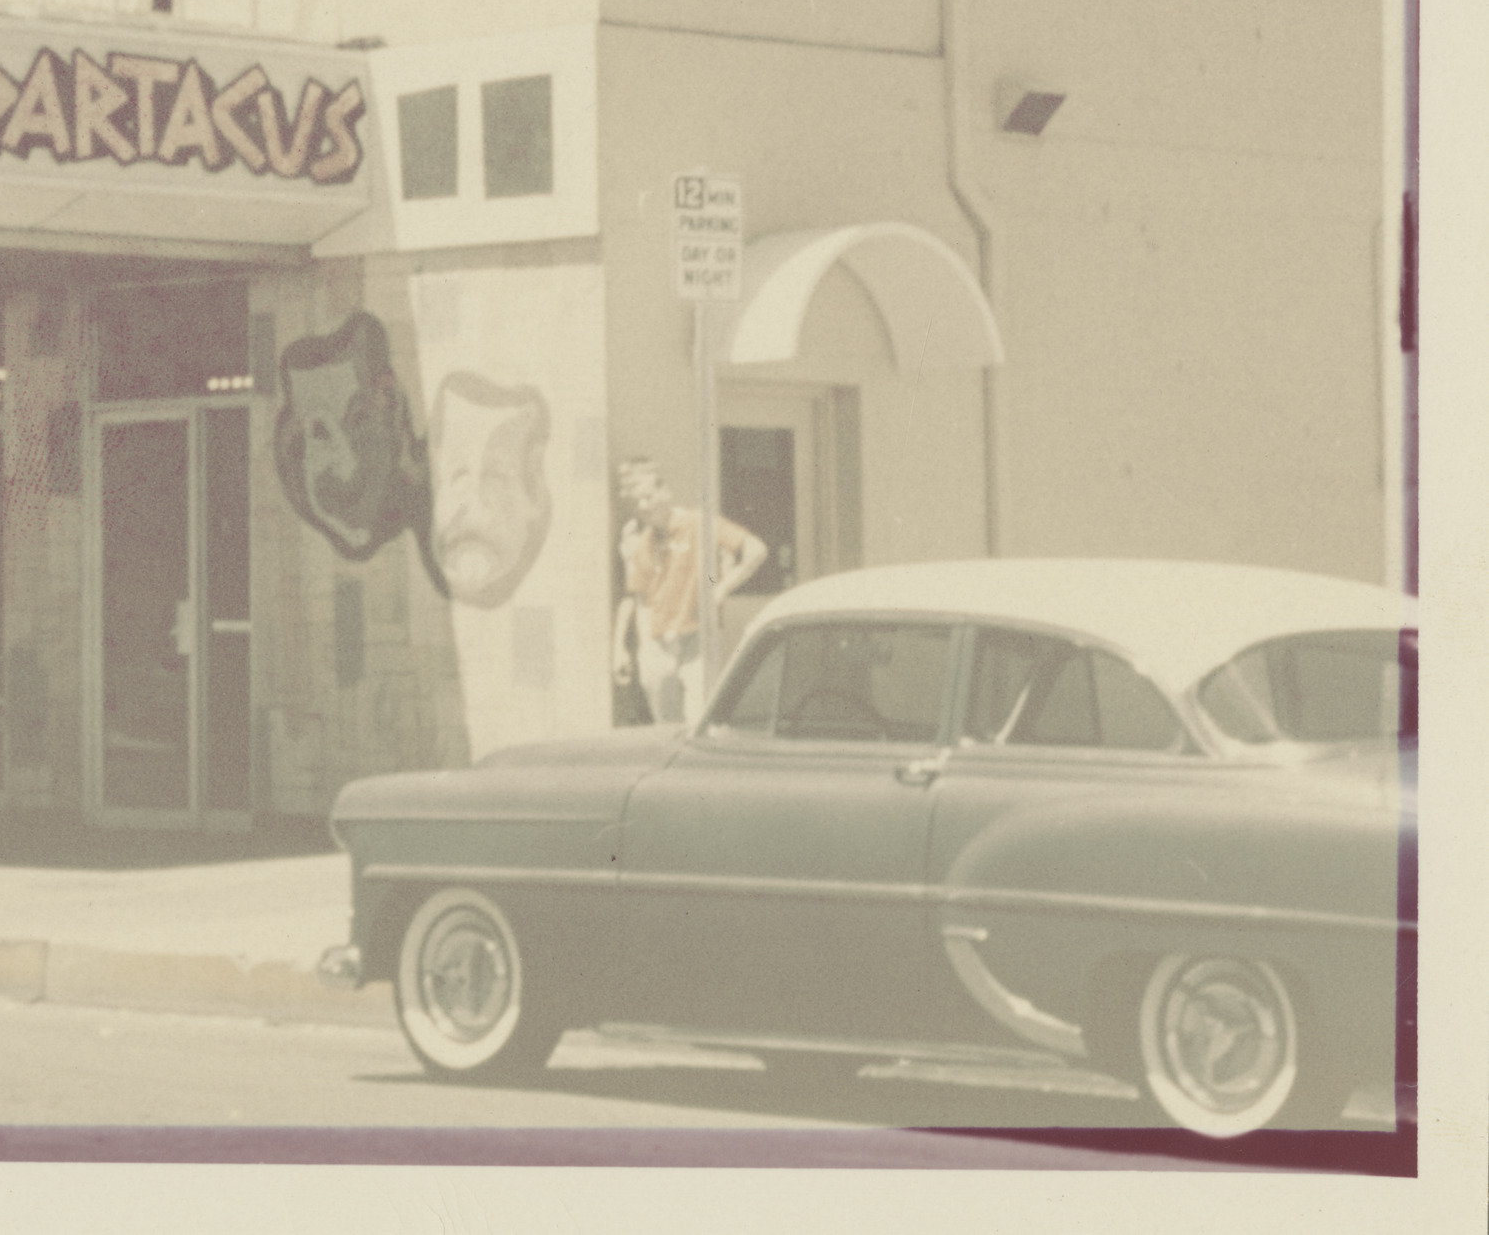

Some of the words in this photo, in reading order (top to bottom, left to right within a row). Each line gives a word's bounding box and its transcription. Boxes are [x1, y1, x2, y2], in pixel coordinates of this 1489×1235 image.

[677, 179, 703, 207] 12
[679, 215, 739, 233] PARKING
[682, 245, 709, 262] DAY
[683, 269, 732, 286] NIGHT
